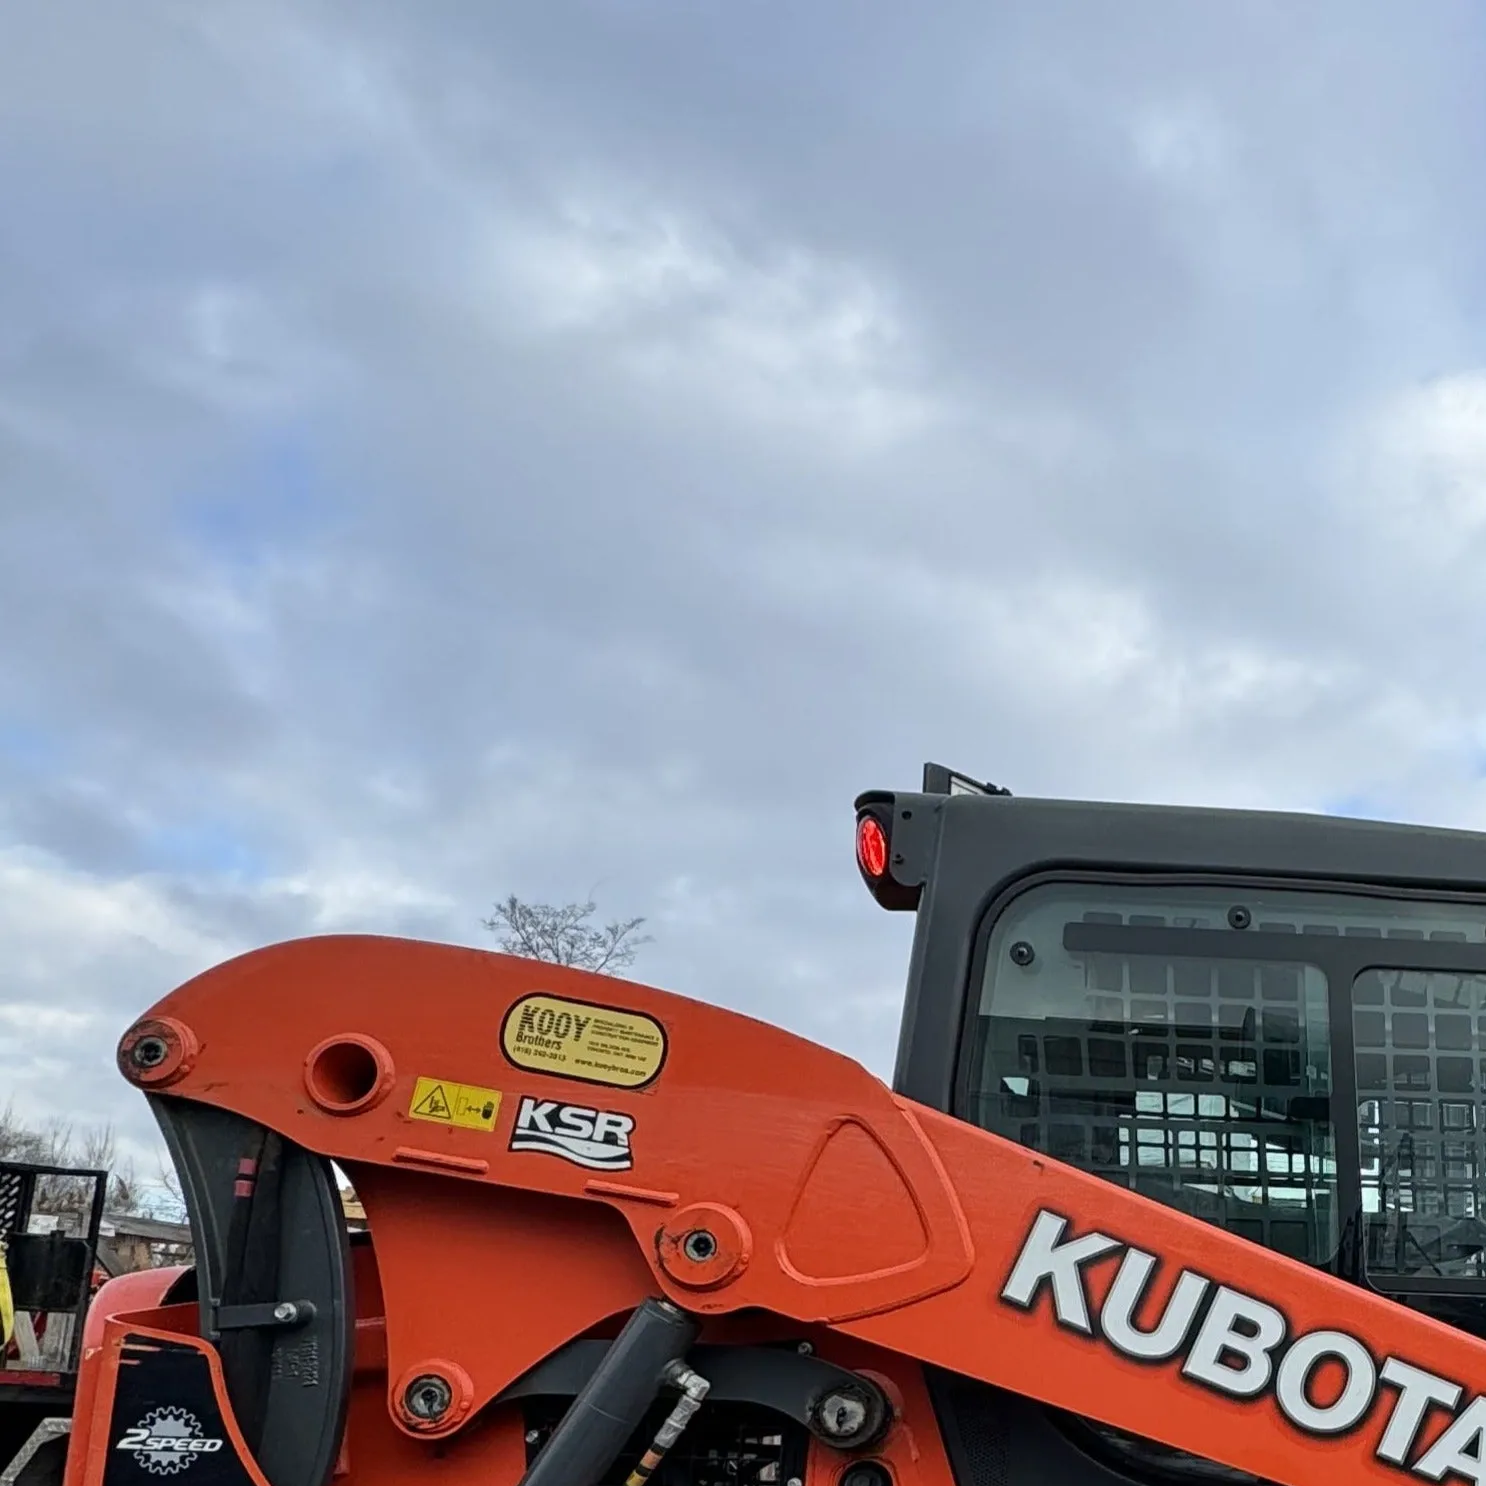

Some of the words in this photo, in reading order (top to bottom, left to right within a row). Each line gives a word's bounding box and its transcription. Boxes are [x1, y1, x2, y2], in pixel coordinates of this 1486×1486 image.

[516, 1031, 563, 1051] Brothers
[518, 1005, 591, 1041] KOOY
[517, 1098, 634, 1146] KSR
